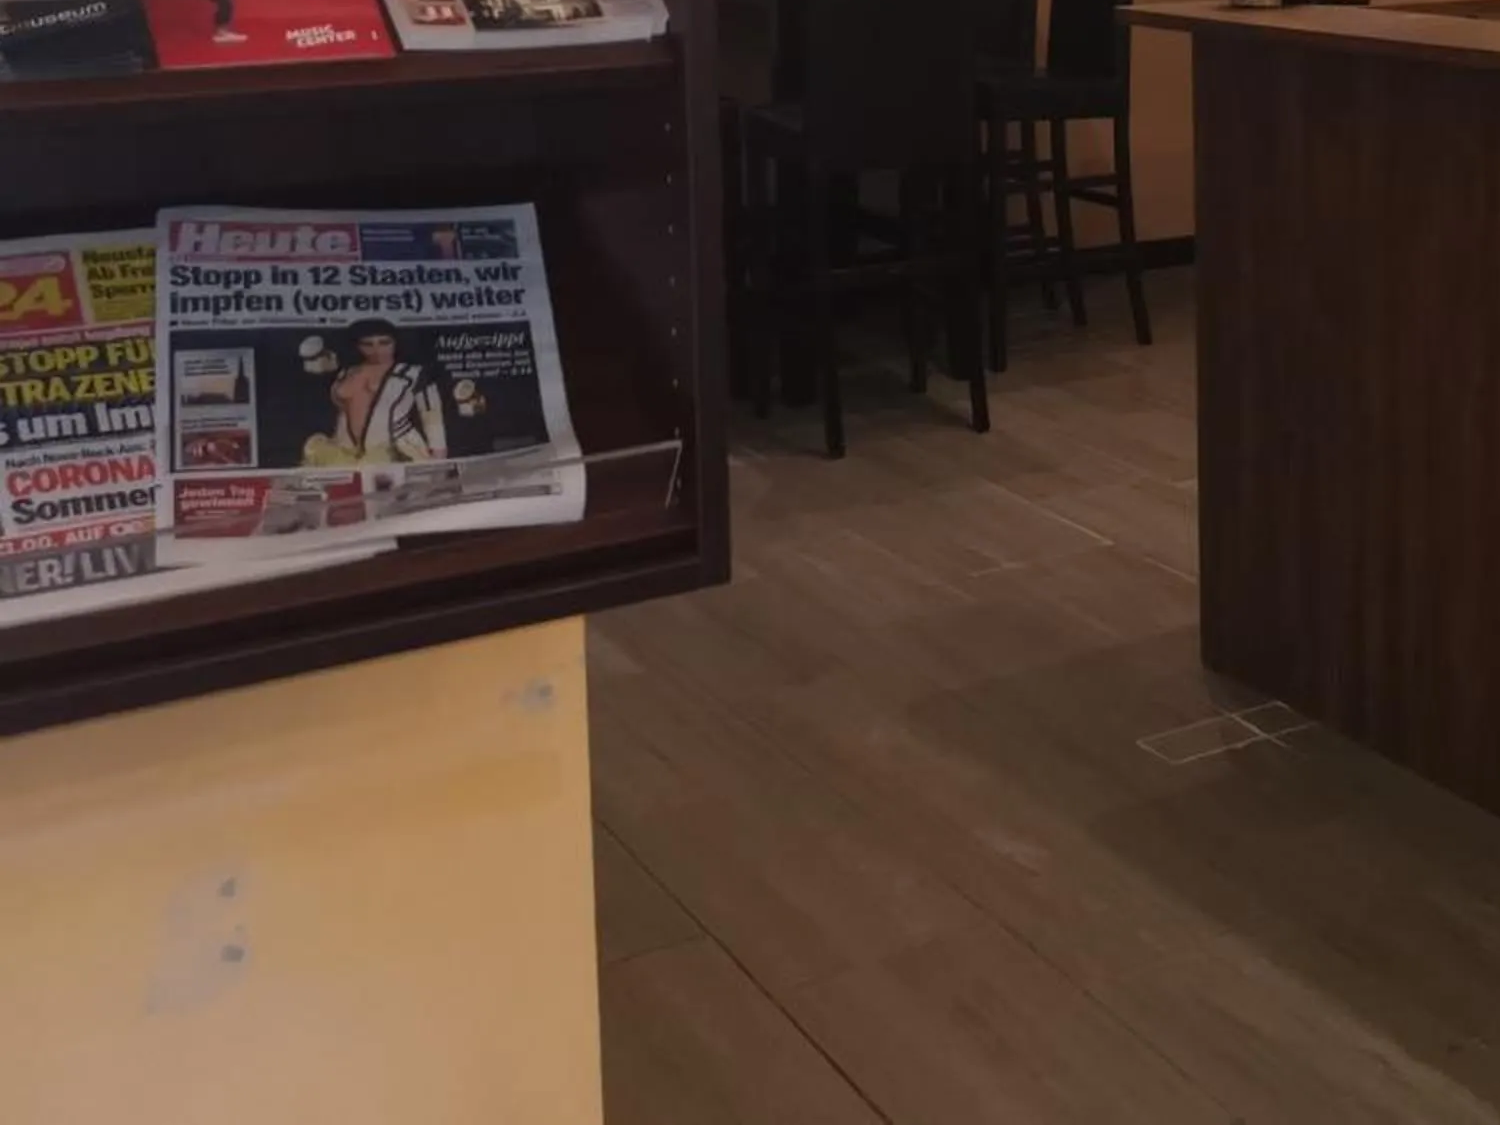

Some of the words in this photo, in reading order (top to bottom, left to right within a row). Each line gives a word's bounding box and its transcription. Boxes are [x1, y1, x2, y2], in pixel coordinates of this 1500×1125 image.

[172, 222, 352, 258] Heute
[169, 264, 263, 290] Stopp
[271, 264, 298, 284] in
[308, 265, 341, 286] 12
[348, 263, 471, 287] Staaten,
[474, 261, 523, 283] wir
[169, 290, 284, 316] impfen
[294, 287, 424, 316] (vorerst)
[430, 285, 526, 309] weiter
[0, 345, 99, 375] STOPP
[17, 411, 88, 442] um
[7, 455, 156, 498] CORONA
[12, 484, 162, 525] Sommer
[65, 528, 106, 547] AUF
